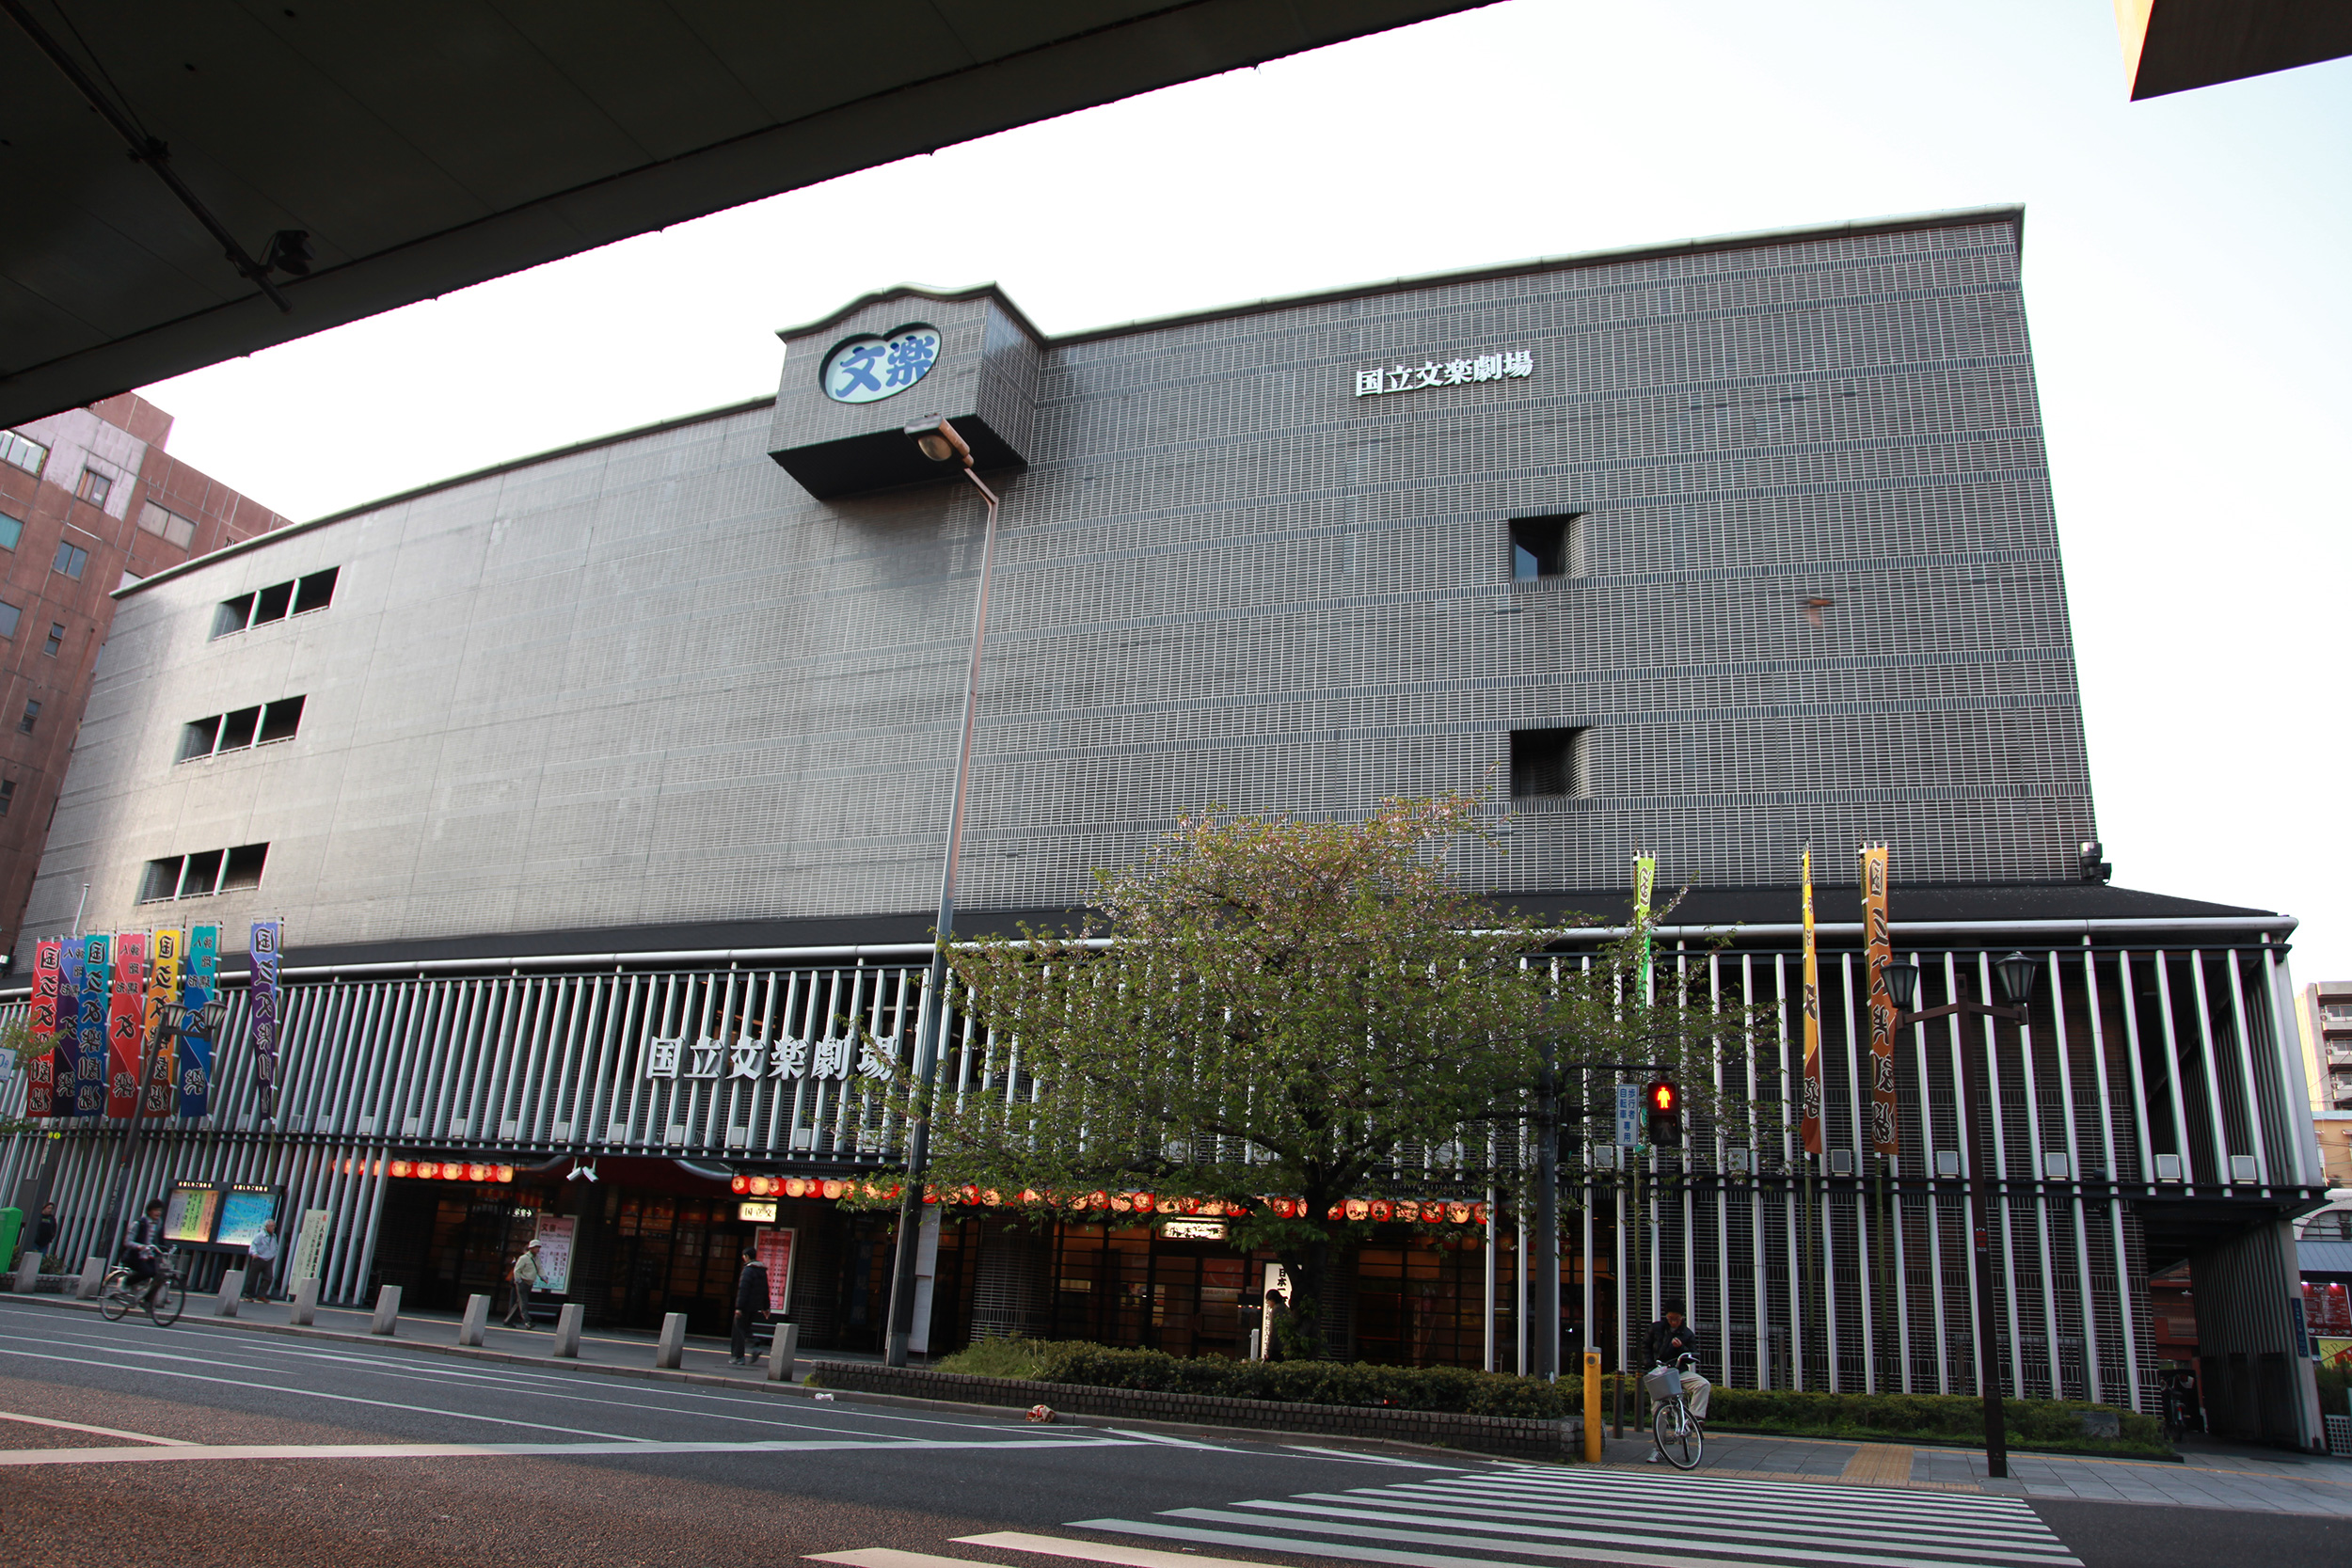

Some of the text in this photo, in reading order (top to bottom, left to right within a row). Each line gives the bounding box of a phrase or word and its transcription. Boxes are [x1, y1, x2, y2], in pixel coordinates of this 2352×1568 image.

[835, 335, 935, 398] 文楽
[1356, 350, 1534, 397] 国立文楽劇場
[645, 1034, 898, 1081] 国立文楽劇場
[1628, 1088, 1636, 1119] 歩行者
[1623, 1121, 1631, 1142] 専用
